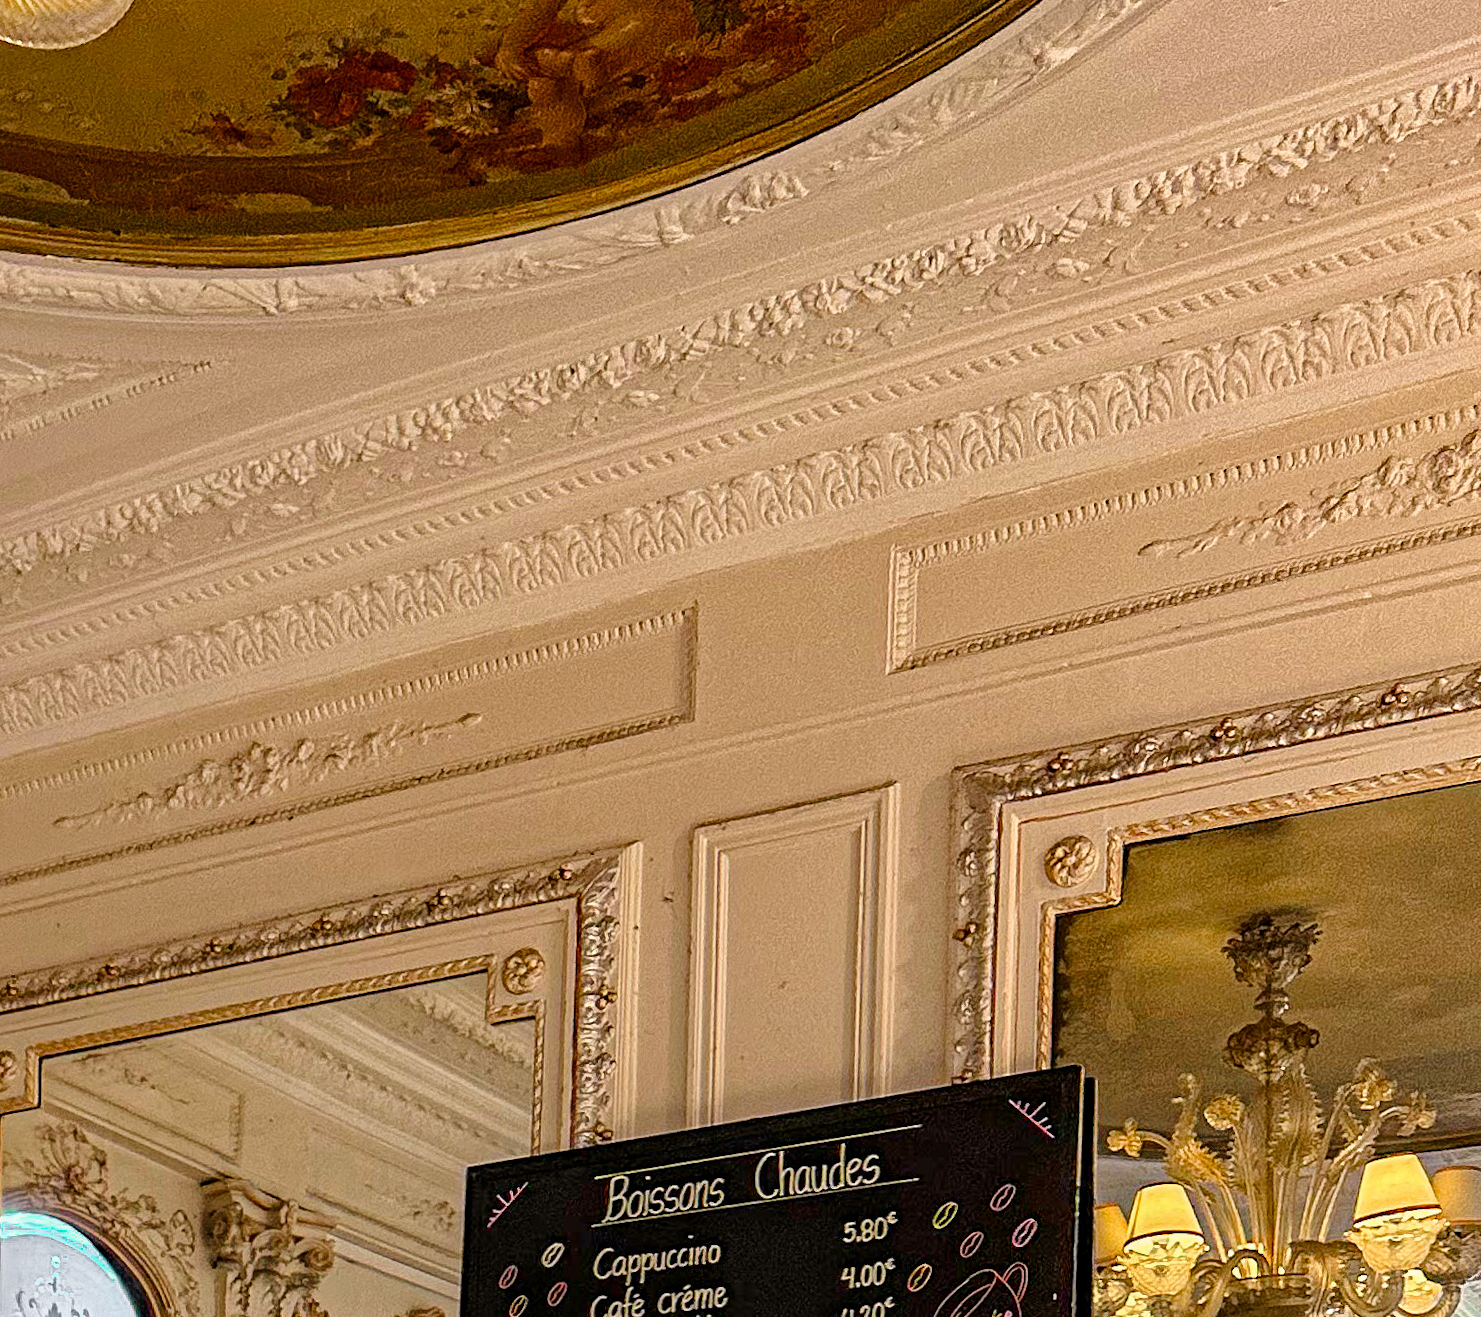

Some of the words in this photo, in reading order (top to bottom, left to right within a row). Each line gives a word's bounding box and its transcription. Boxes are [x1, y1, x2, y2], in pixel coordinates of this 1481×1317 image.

[601, 1175, 725, 1223] Boissons
[755, 1143, 881, 1199] Chaudes
[593, 1235, 720, 1286] Cappuccino
